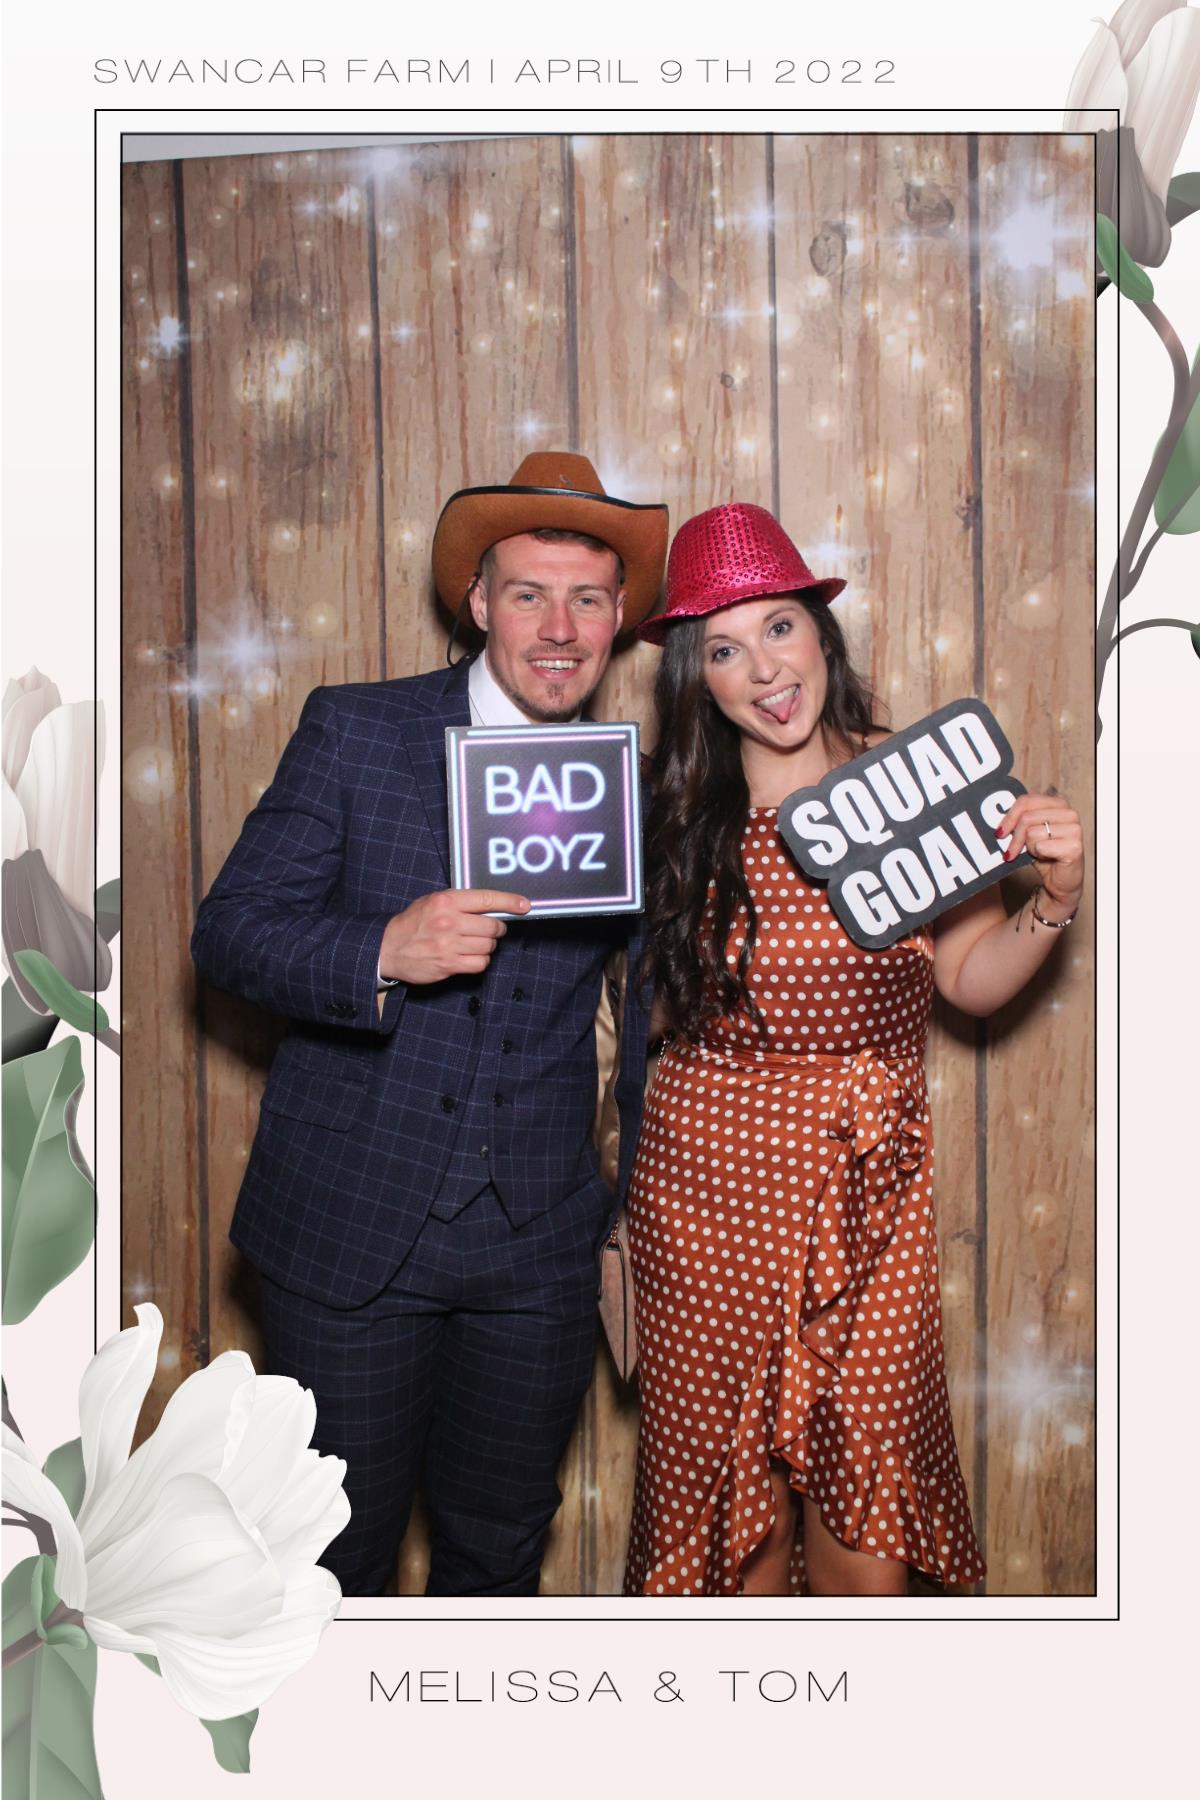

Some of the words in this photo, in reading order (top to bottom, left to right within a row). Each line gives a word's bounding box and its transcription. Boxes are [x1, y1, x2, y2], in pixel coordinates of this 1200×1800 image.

[485, 762, 606, 815] BAD
[791, 712, 1002, 867] SQUAD
[488, 833, 607, 875] BOYZ
